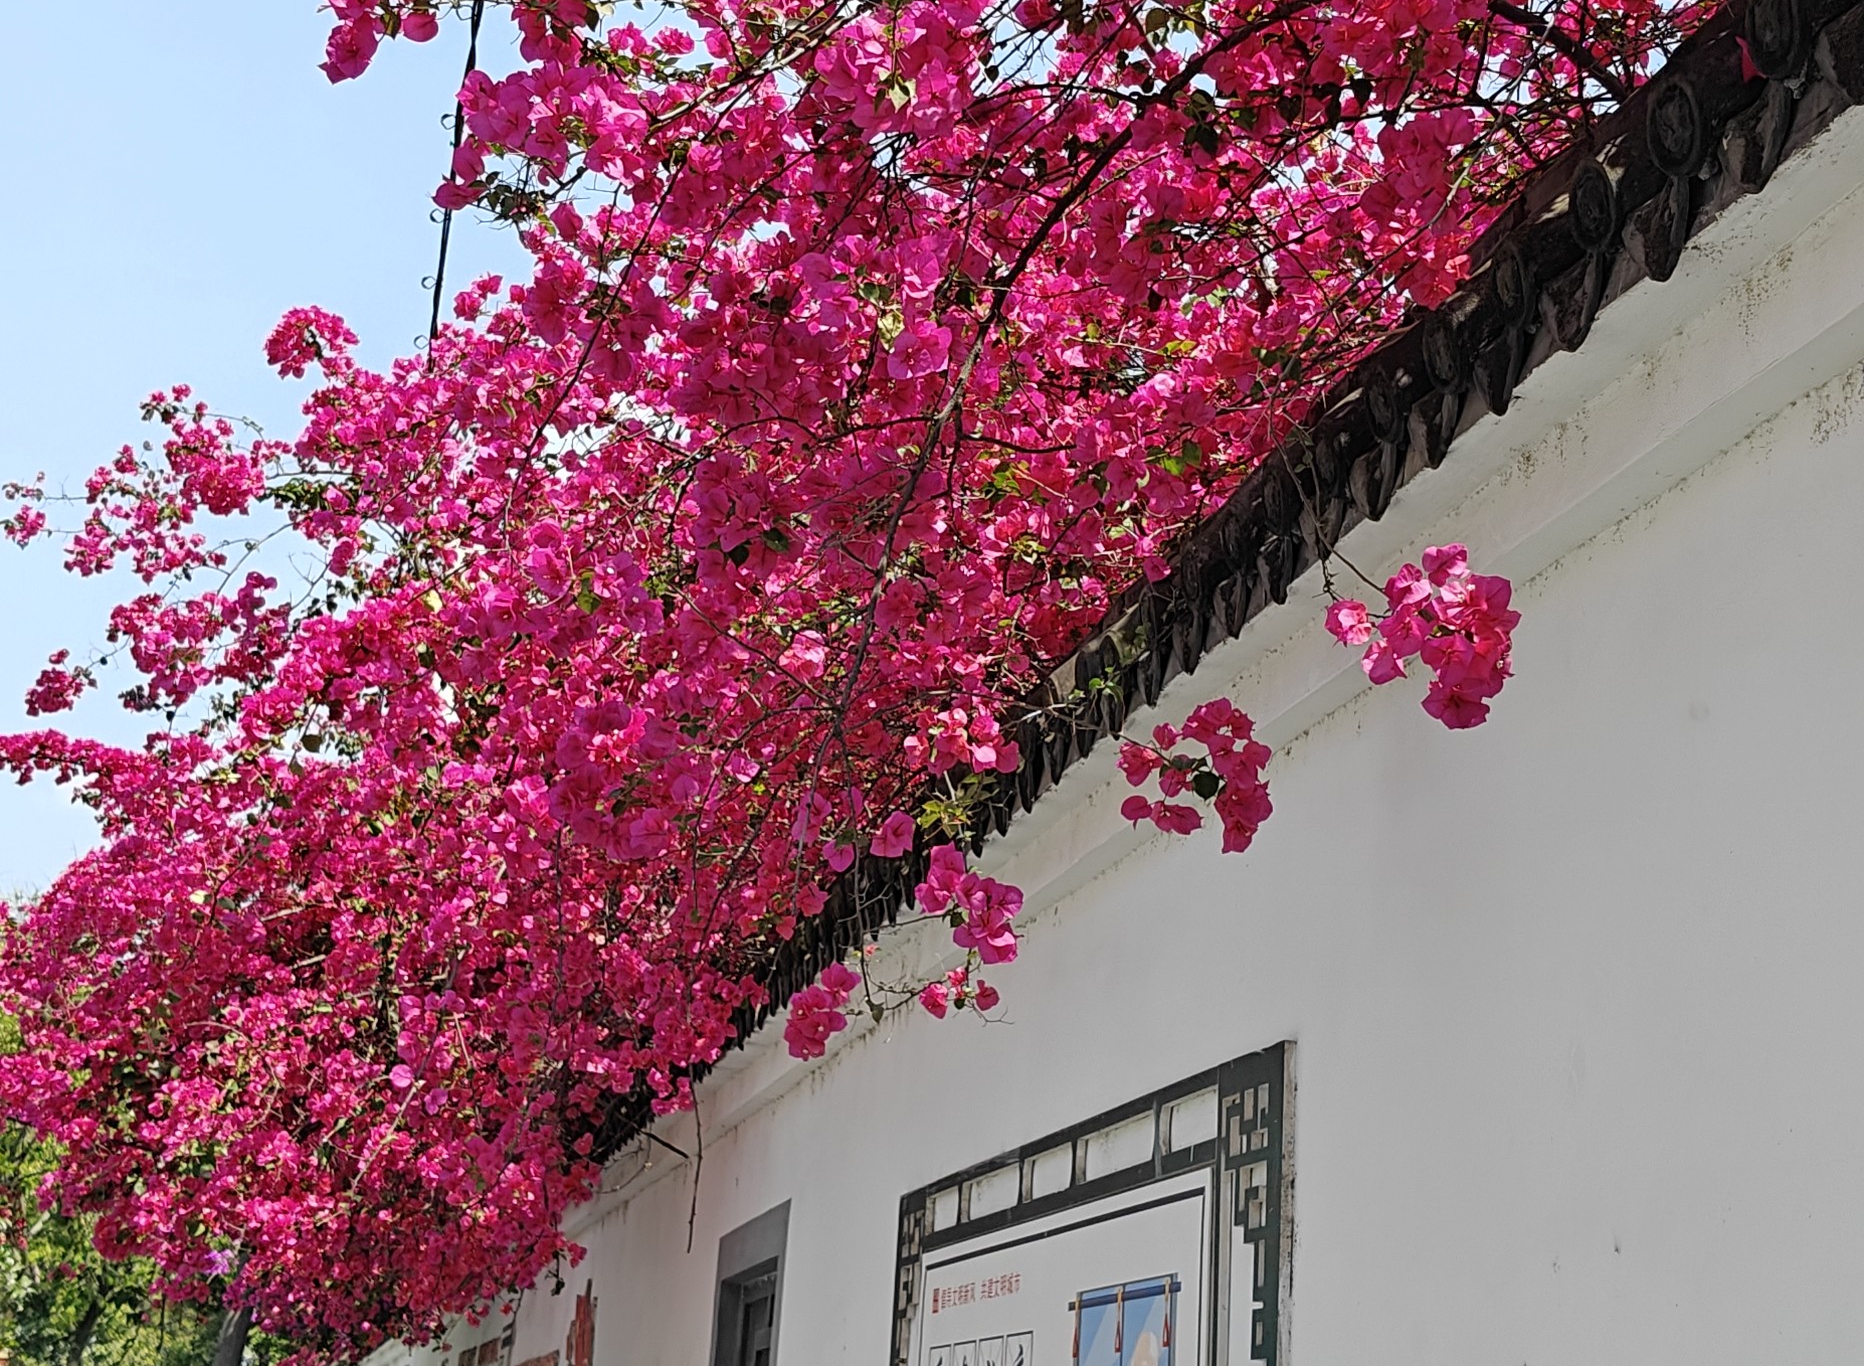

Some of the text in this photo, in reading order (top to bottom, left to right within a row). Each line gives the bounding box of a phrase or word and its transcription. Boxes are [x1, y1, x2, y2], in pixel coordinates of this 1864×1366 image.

[980, 1272, 1021, 1300] 共建文明城市
